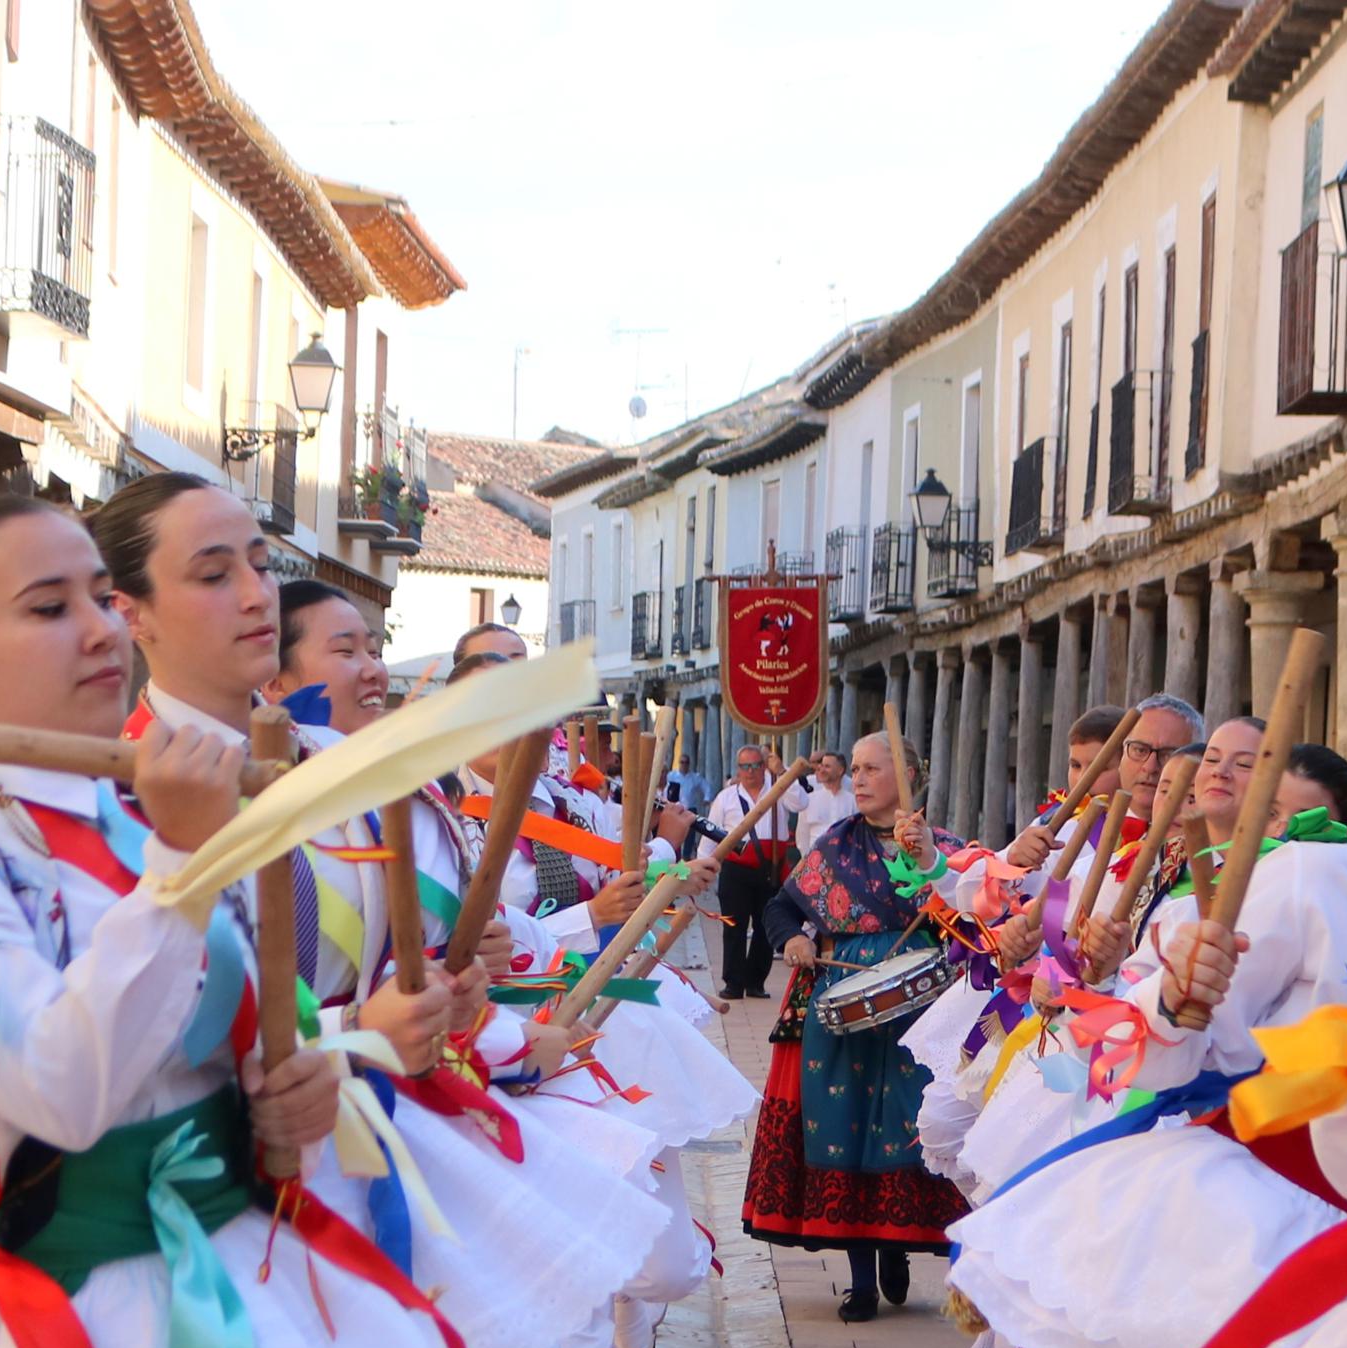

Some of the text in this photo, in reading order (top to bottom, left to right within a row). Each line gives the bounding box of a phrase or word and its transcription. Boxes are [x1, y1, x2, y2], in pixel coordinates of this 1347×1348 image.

[734, 605, 754, 619] Grupo
[755, 600, 763, 608] de
[764, 597, 784, 605] Coros
[756, 659, 789, 669] Pilarica
[758, 686, 789, 694] Valladolid
